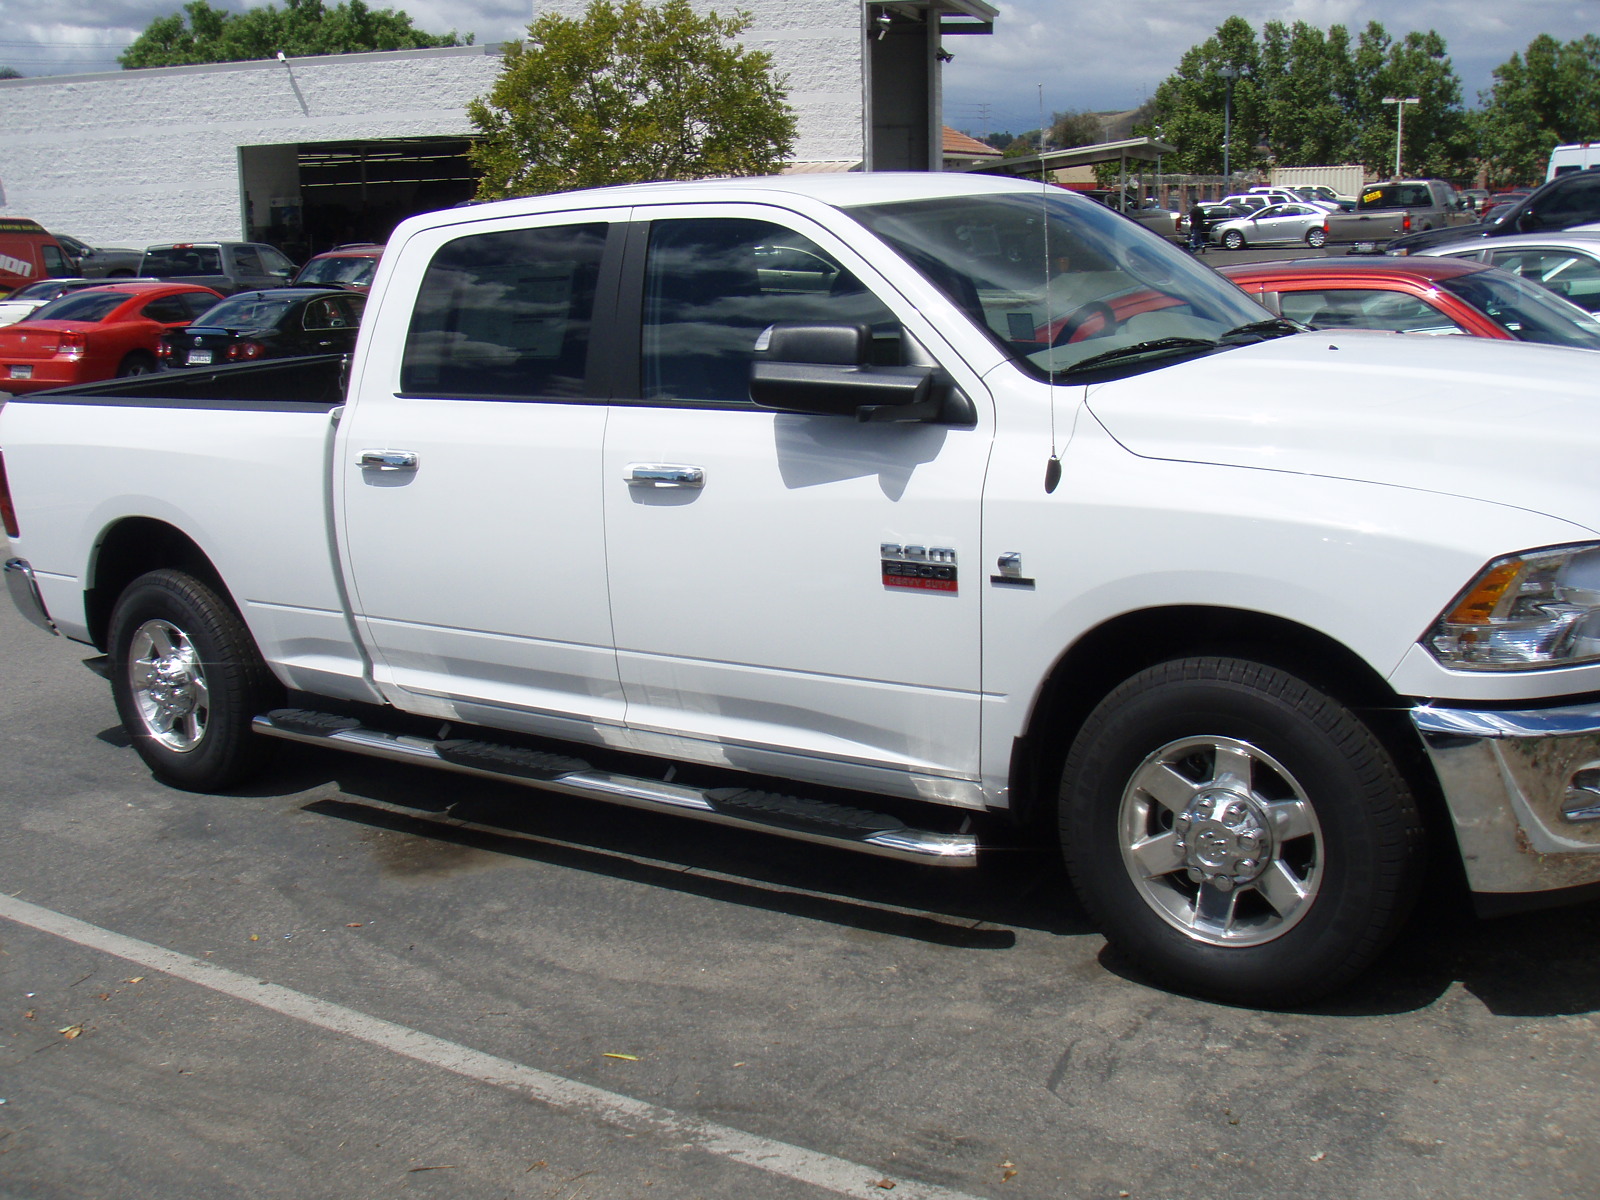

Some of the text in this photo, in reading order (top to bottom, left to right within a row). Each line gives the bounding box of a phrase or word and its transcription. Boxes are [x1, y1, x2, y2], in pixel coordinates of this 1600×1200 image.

[886, 562, 951, 579] 2500
[889, 576, 951, 589] HEAVY DUTY
